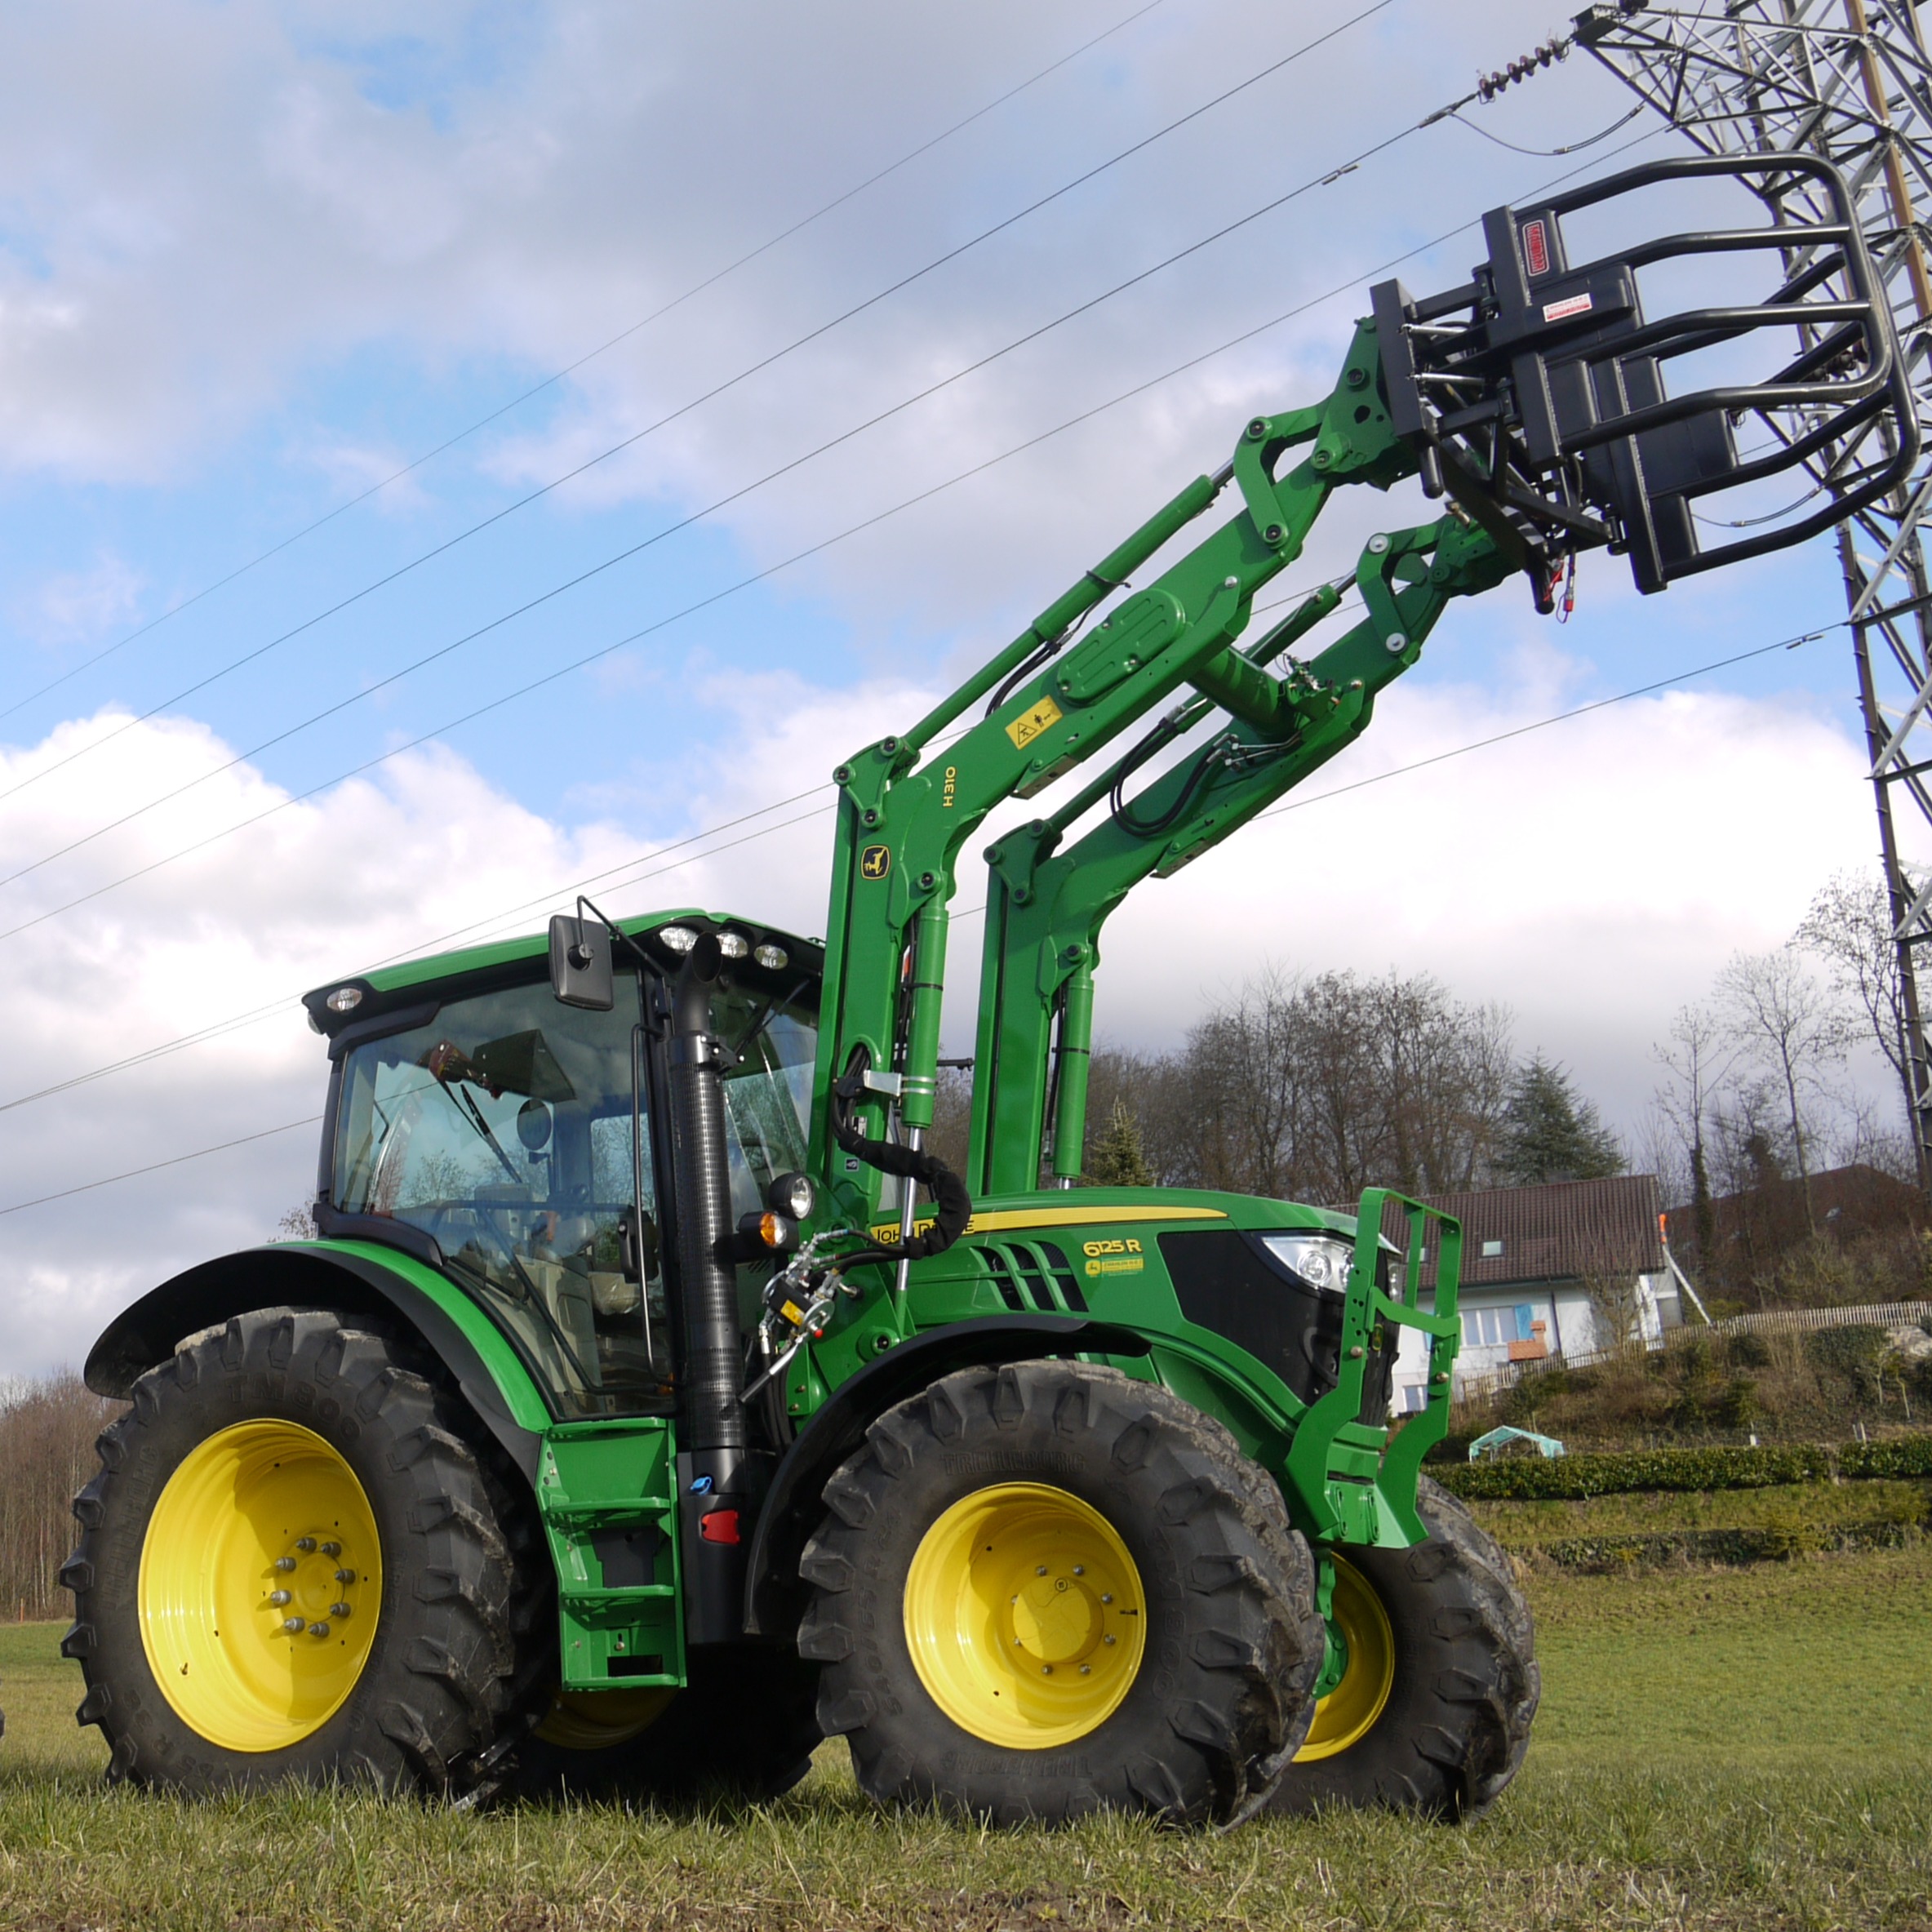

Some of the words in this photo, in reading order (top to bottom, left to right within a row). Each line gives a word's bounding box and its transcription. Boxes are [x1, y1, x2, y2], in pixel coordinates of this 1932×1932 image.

[1083, 1240, 1126, 1257] 6125
[1126, 1239, 1143, 1253] R
[939, 1450, 1086, 1476] TRELLEBORG
